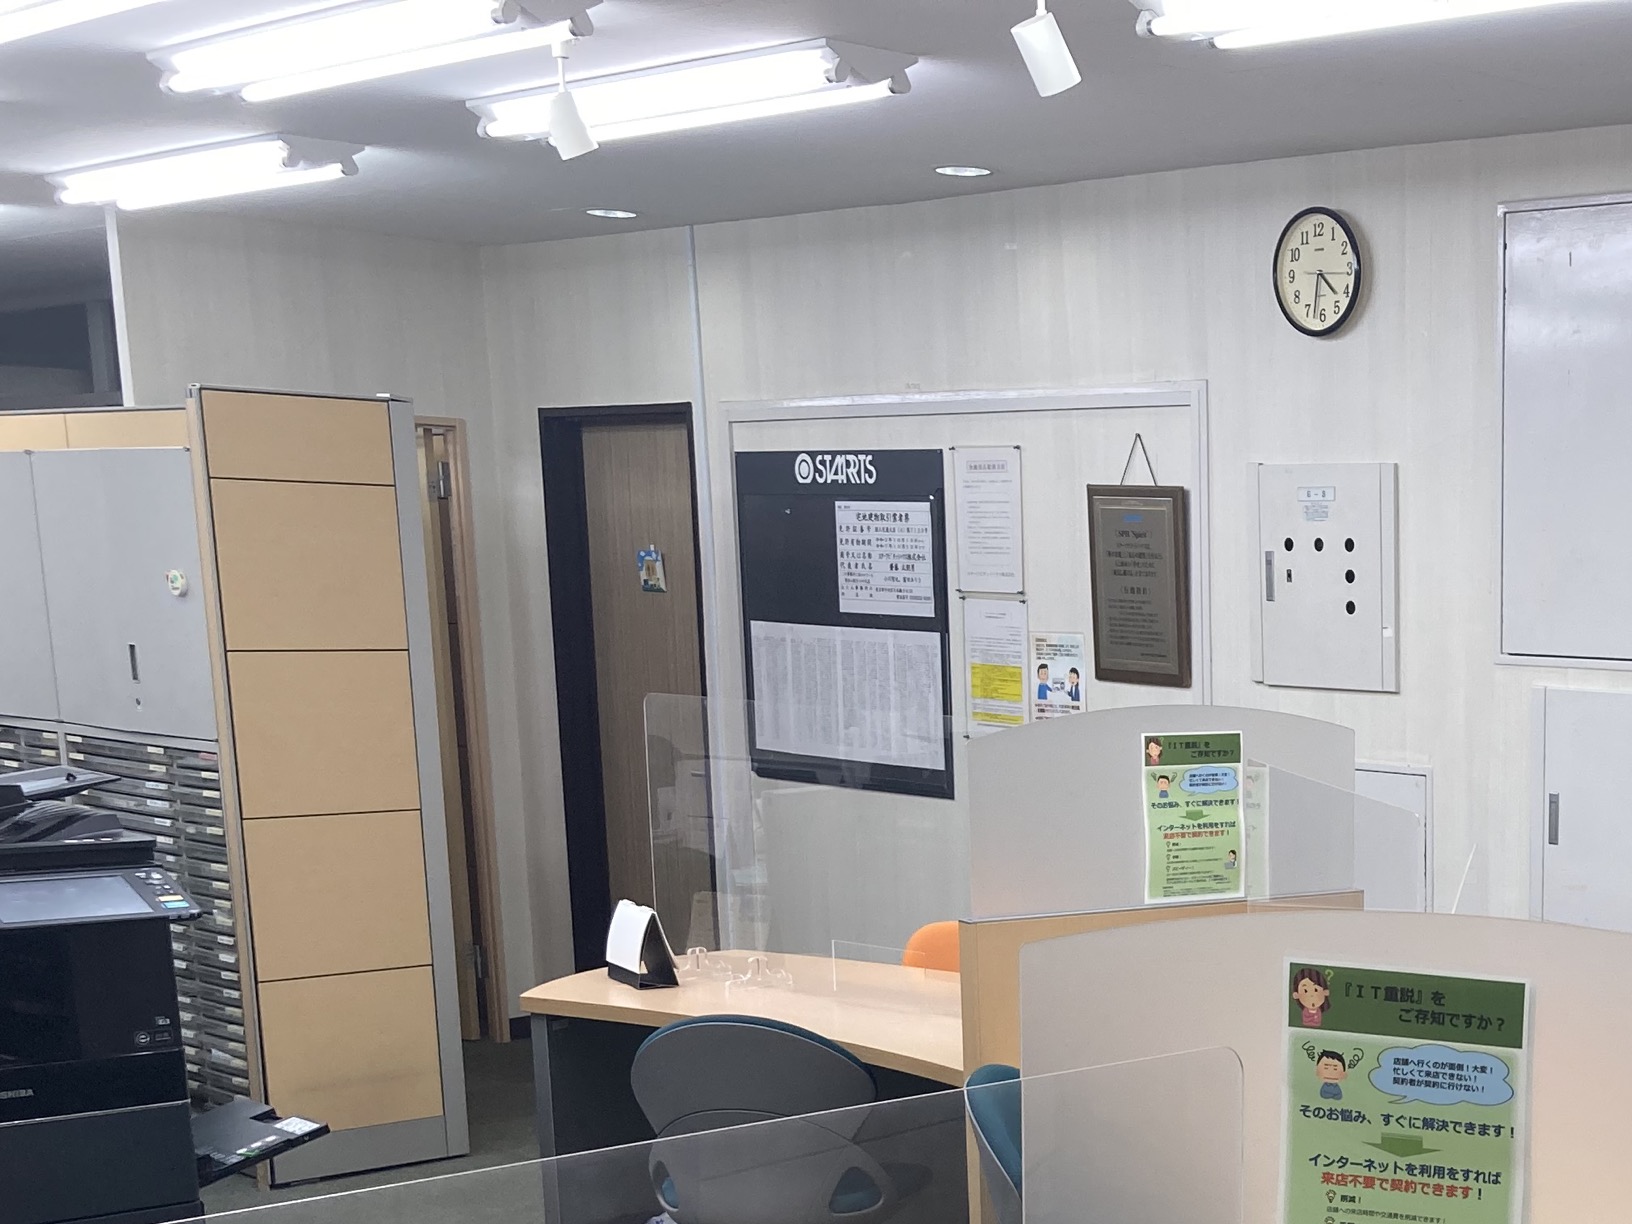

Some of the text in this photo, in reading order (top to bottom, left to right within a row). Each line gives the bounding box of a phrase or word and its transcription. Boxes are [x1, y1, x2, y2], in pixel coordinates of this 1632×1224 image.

[1313, 222, 1324, 237] 12
[1331, 227, 1335, 241] 1
[1301, 231, 1309, 245] 11
[1290, 248, 1300, 262] 10
[1341, 241, 1348, 255] 2
[1347, 262, 1353, 276] 3
[1289, 270, 1295, 283] 9
[1294, 290, 1300, 304] 8
[1343, 284, 1350, 298] 4
[1305, 304, 1311, 318] 7
[1334, 301, 1340, 315] 5
[1320, 309, 1326, 322] 6
[1398, 1007, 1506, 1032] ご存知ですか？
[1392, 1066, 1478, 1083] 忙しくて来店できない！
[1392, 1076, 1486, 1093] 契約者が契約に行けない！
[1299, 1104, 1515, 1140] そのお悩み、すぐに解決できます！
[1308, 1152, 1503, 1186] インターネットを利用をすれば
[1320, 1171, 1483, 1200] 来店不要で契約できます！
